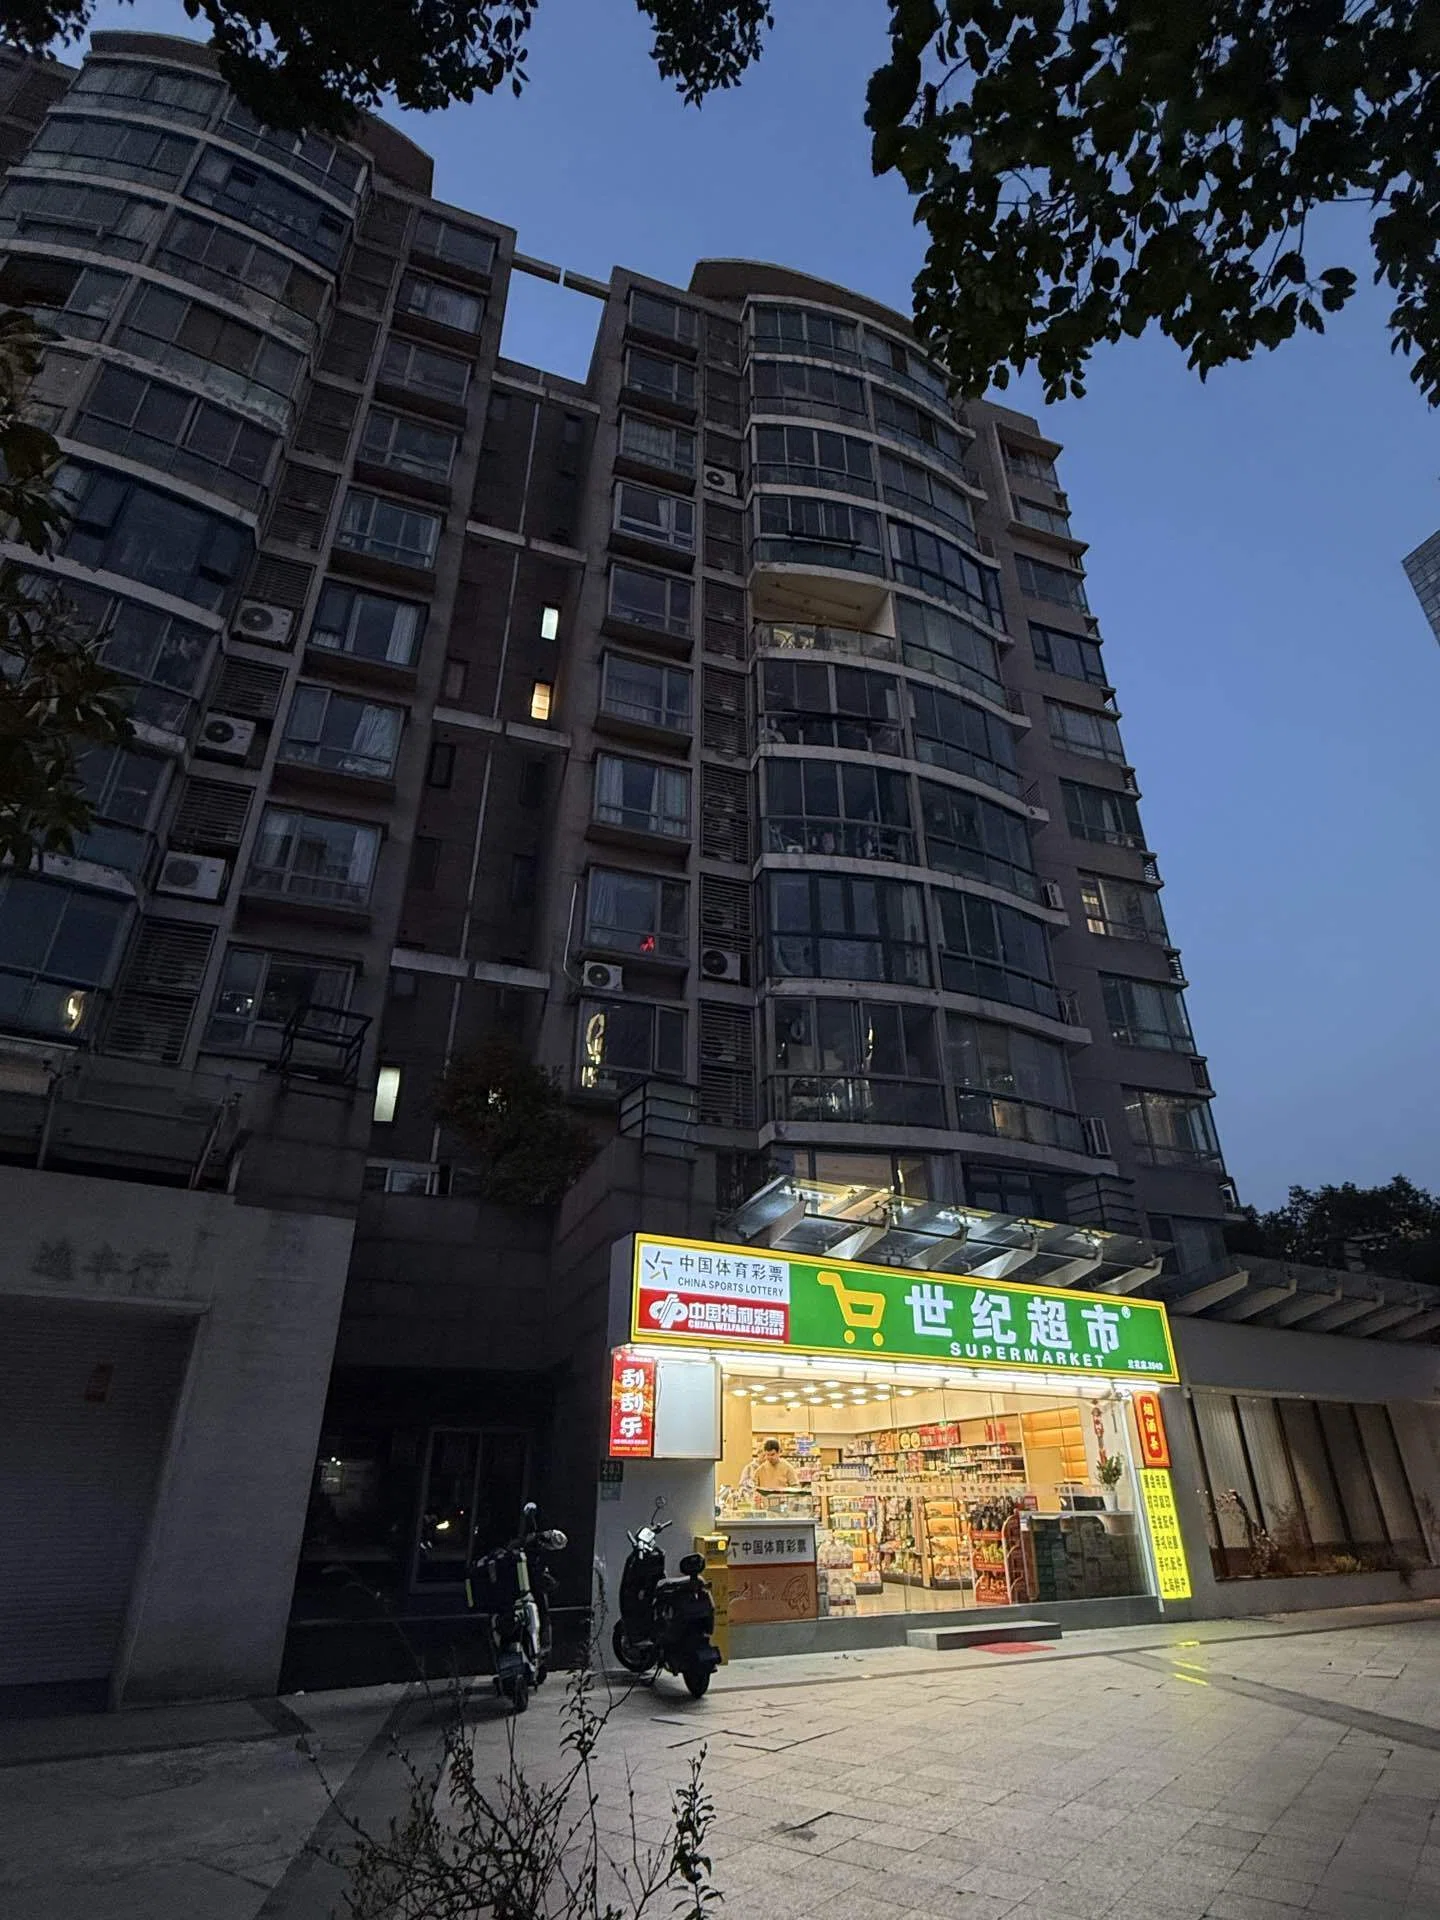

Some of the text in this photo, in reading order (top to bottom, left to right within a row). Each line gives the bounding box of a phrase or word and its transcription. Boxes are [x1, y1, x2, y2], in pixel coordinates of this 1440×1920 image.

[680, 1254, 783, 1283] 中国体育彩票
[678, 1277, 784, 1298] CHINA SPORTS LOTTERY
[688, 1302, 784, 1328] 中国福利彩票
[905, 1284, 1120, 1354] 世纪超市
[688, 1320, 783, 1337] CHINA WELFARE LOTTERY
[950, 1341, 1104, 1368] SUPERMARKET
[620, 1368, 645, 1438] 刮刮乐
[742, 1538, 807, 1555] 中国体育彩票
